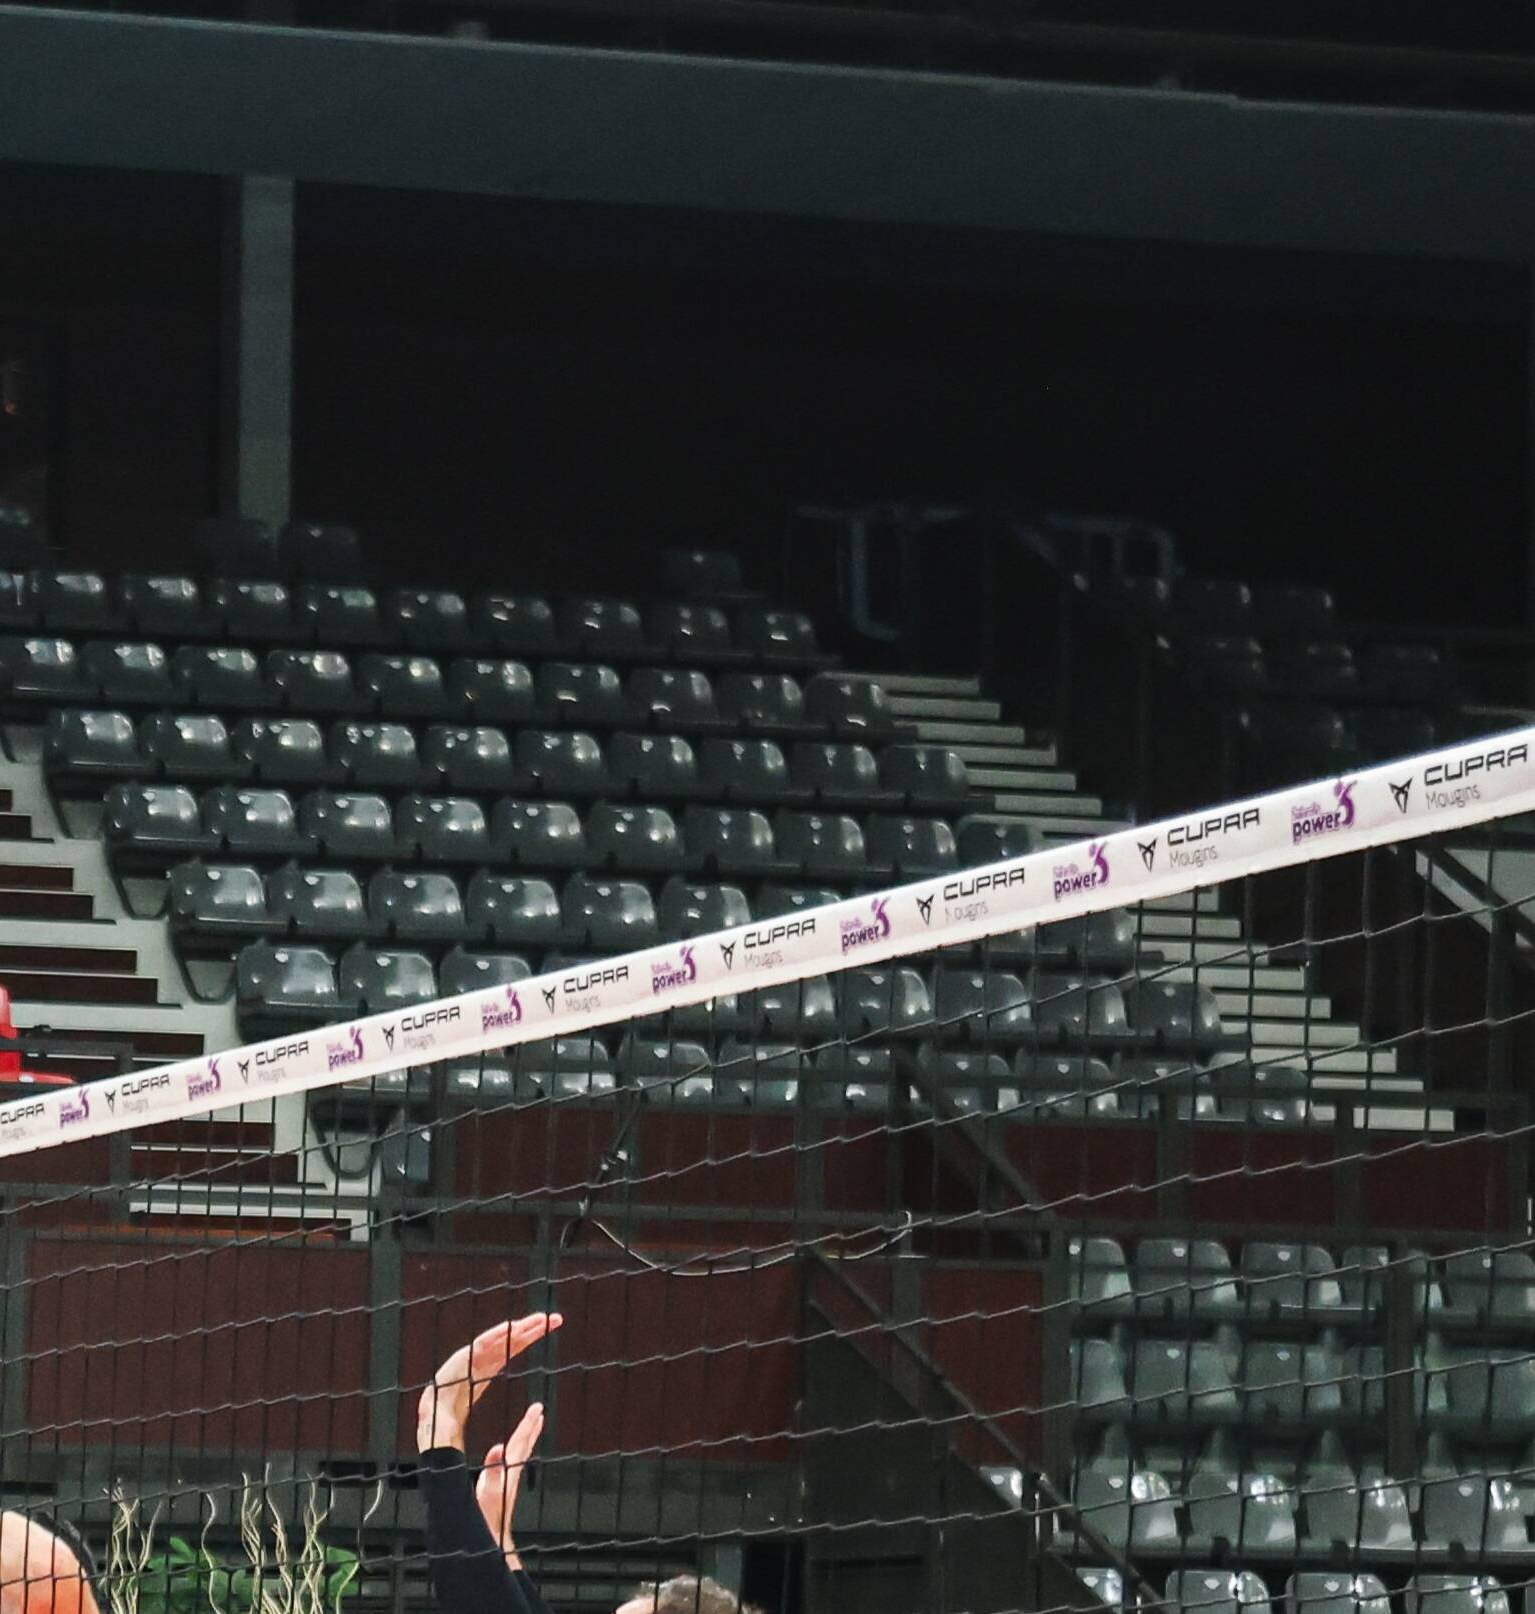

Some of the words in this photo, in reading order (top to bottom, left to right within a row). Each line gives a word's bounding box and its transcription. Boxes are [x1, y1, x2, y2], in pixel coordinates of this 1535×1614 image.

[1424, 744, 1528, 786] CUPRA
[1426, 784, 1481, 810] Mougins
[1167, 807, 1261, 846] CUPRA
[1169, 844, 1219, 869] Mougins
[943, 867, 1025, 900] CUPRA
[743, 918, 817, 949] CUPRA
[563, 965, 629, 994] CUPRA
[401, 1005, 461, 1032] CUPRA
[254, 1040, 309, 1066] CUPRA
[120, 1073, 170, 1097] CUPRA
[0, 1103, 45, 1125] CUPRA
